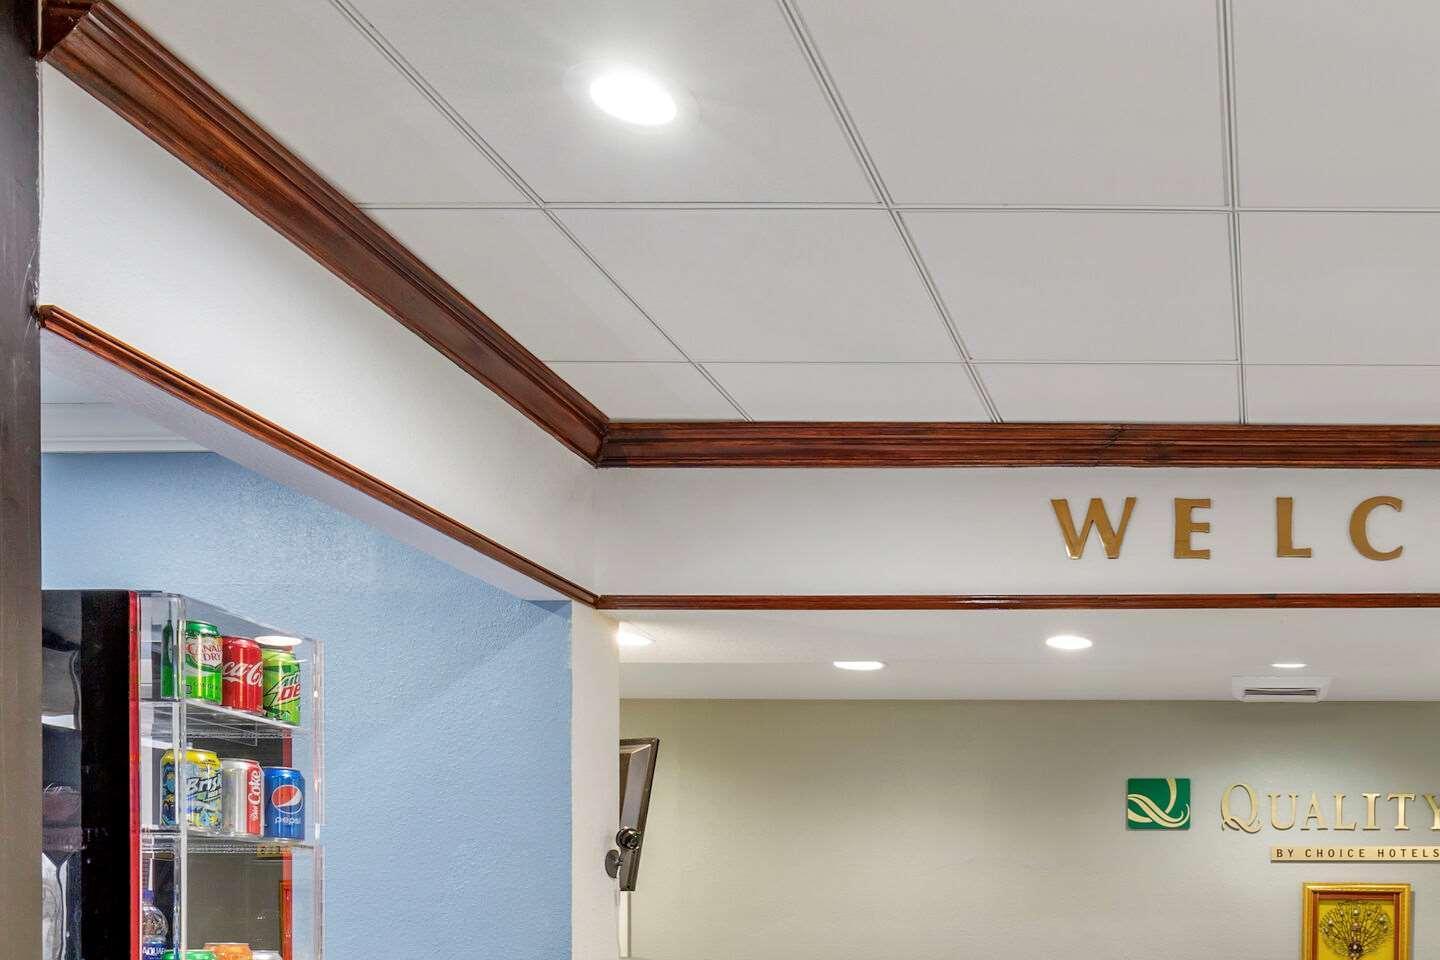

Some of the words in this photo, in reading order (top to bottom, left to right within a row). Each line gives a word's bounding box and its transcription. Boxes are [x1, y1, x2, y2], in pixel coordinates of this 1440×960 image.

[247, 770, 260, 804] Coke
[1276, 848, 1294, 858] BY
[1305, 848, 1365, 858] CHOICE
[1377, 848, 1440, 858] HOTELS
